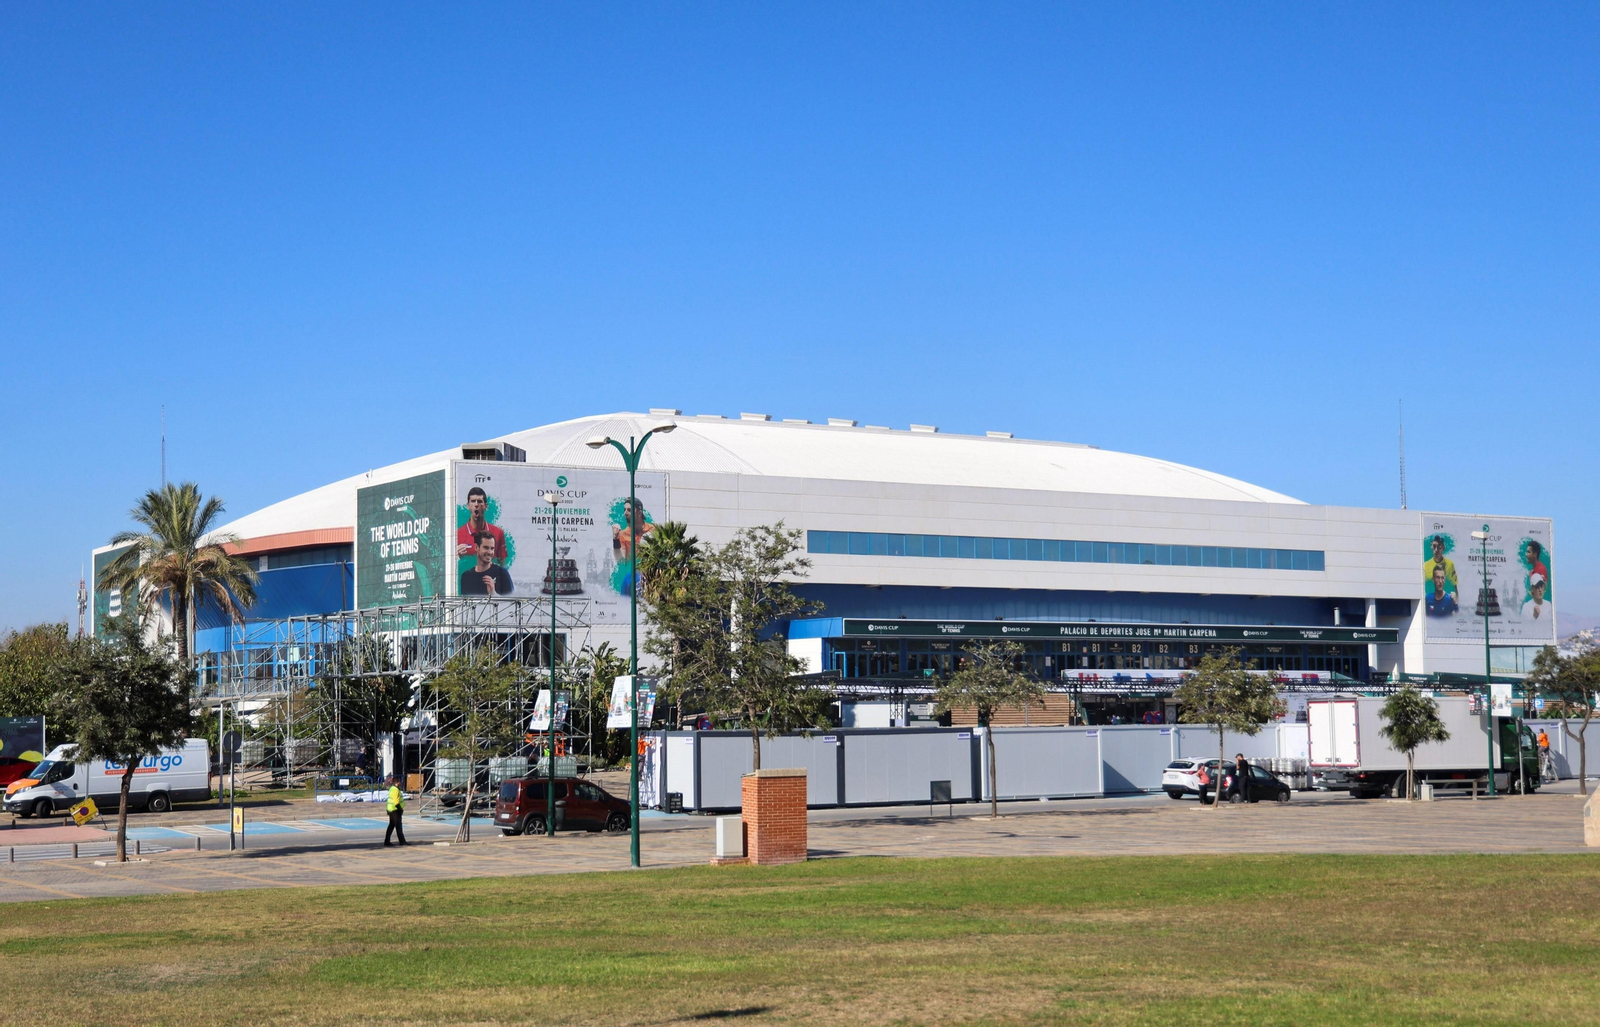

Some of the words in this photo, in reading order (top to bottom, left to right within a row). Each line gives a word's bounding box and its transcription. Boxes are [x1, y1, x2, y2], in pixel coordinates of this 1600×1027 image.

[537, 490, 564, 498] DAVIS
[567, 490, 588, 498] CUP
[390, 496, 404, 507] DAVIS
[404, 494, 414, 504] CUP
[534, 506, 552, 514] 21-26
[561, 517, 594, 526] CARPENA
[370, 526, 385, 542] THE
[386, 520, 413, 540] WORLD
[414, 517, 430, 534] CUP
[381, 542, 390, 558] OF
[392, 538, 419, 556] TENNIS
[395, 560, 413, 570] NOVIEMBRE
[398, 571, 414, 581] CARPENA
[1060, 626, 1086, 635] PALACIO
[1164, 627, 1187, 636] MARTÍN
[1062, 643, 1070, 652] B1
[1092, 644, 1100, 652] B1
[1132, 644, 1141, 653] B2
[1160, 644, 1168, 653] B2
[1189, 645, 1198, 653] B3
